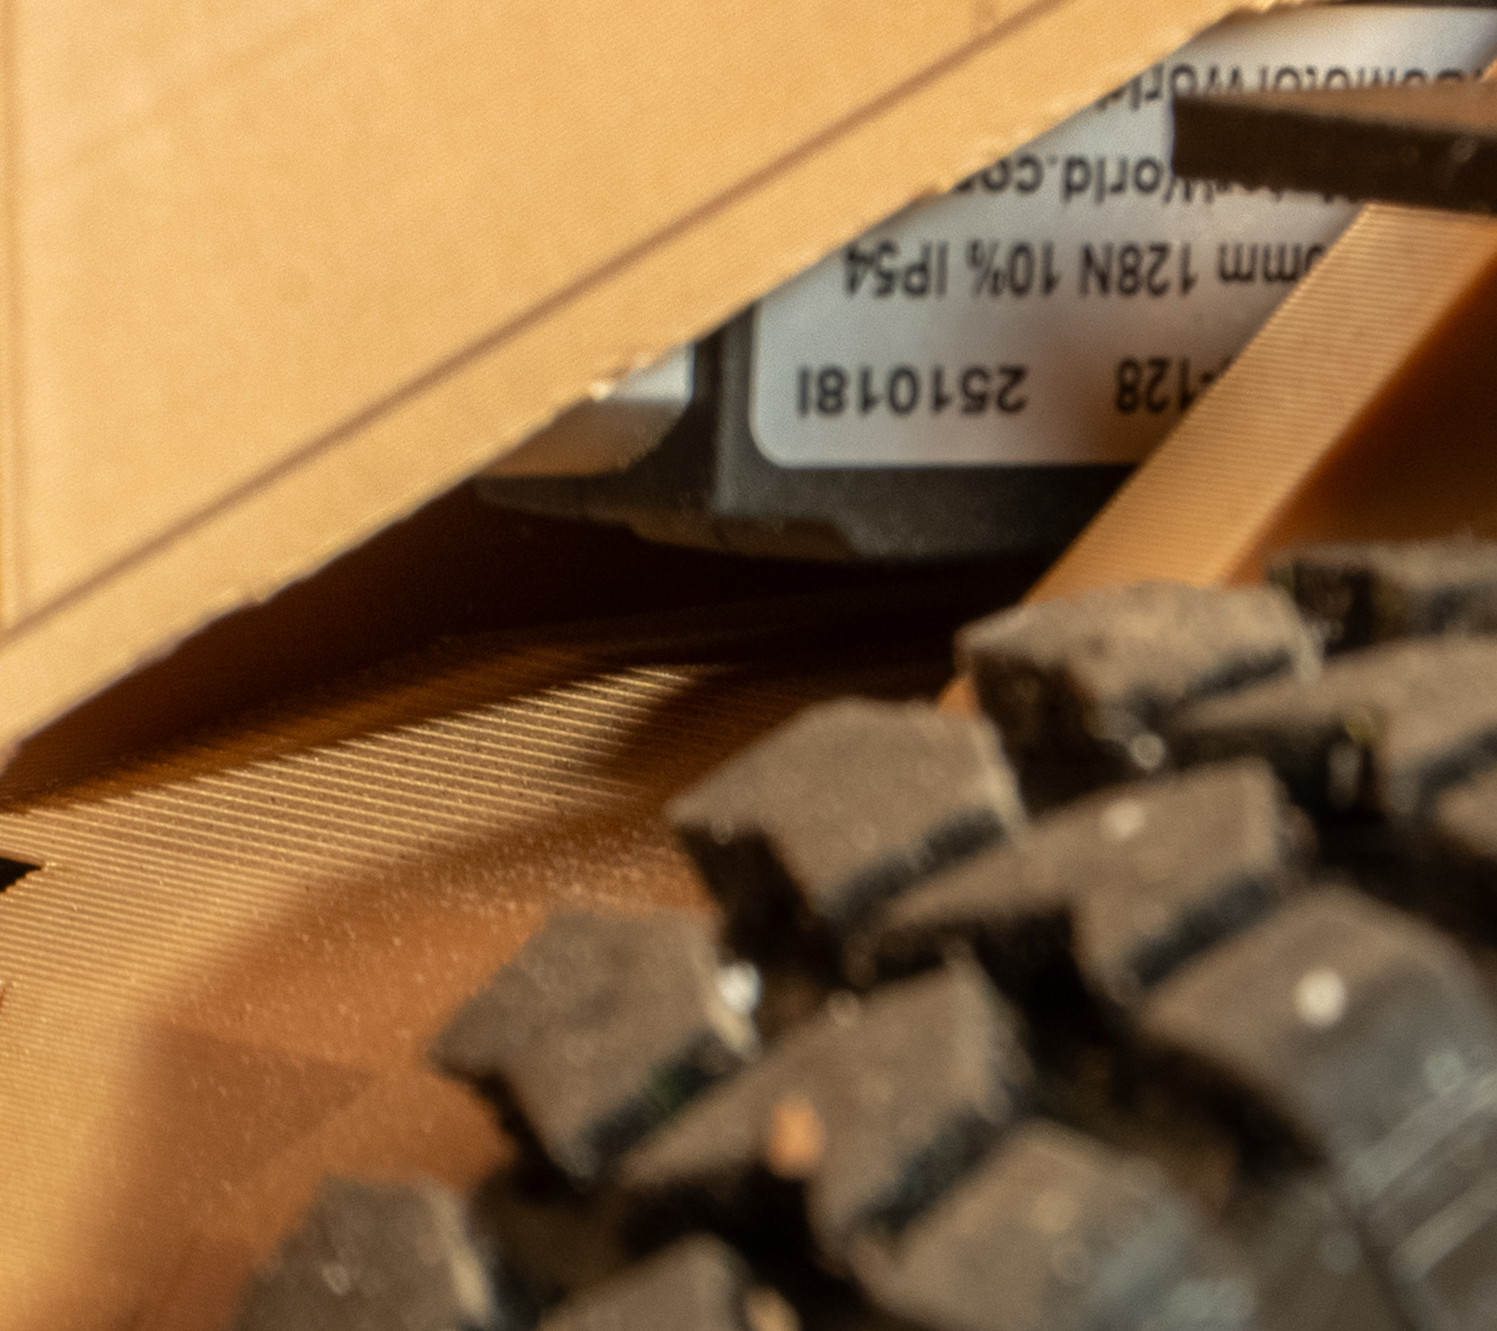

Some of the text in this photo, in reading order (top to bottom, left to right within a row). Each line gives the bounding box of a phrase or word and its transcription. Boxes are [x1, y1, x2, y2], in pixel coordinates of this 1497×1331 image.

[844, 241, 950, 299] IP54
[968, 243, 1062, 298] 10%
[1080, 243, 1198, 299] 128N
[1116, 357, 1220, 416] -128
